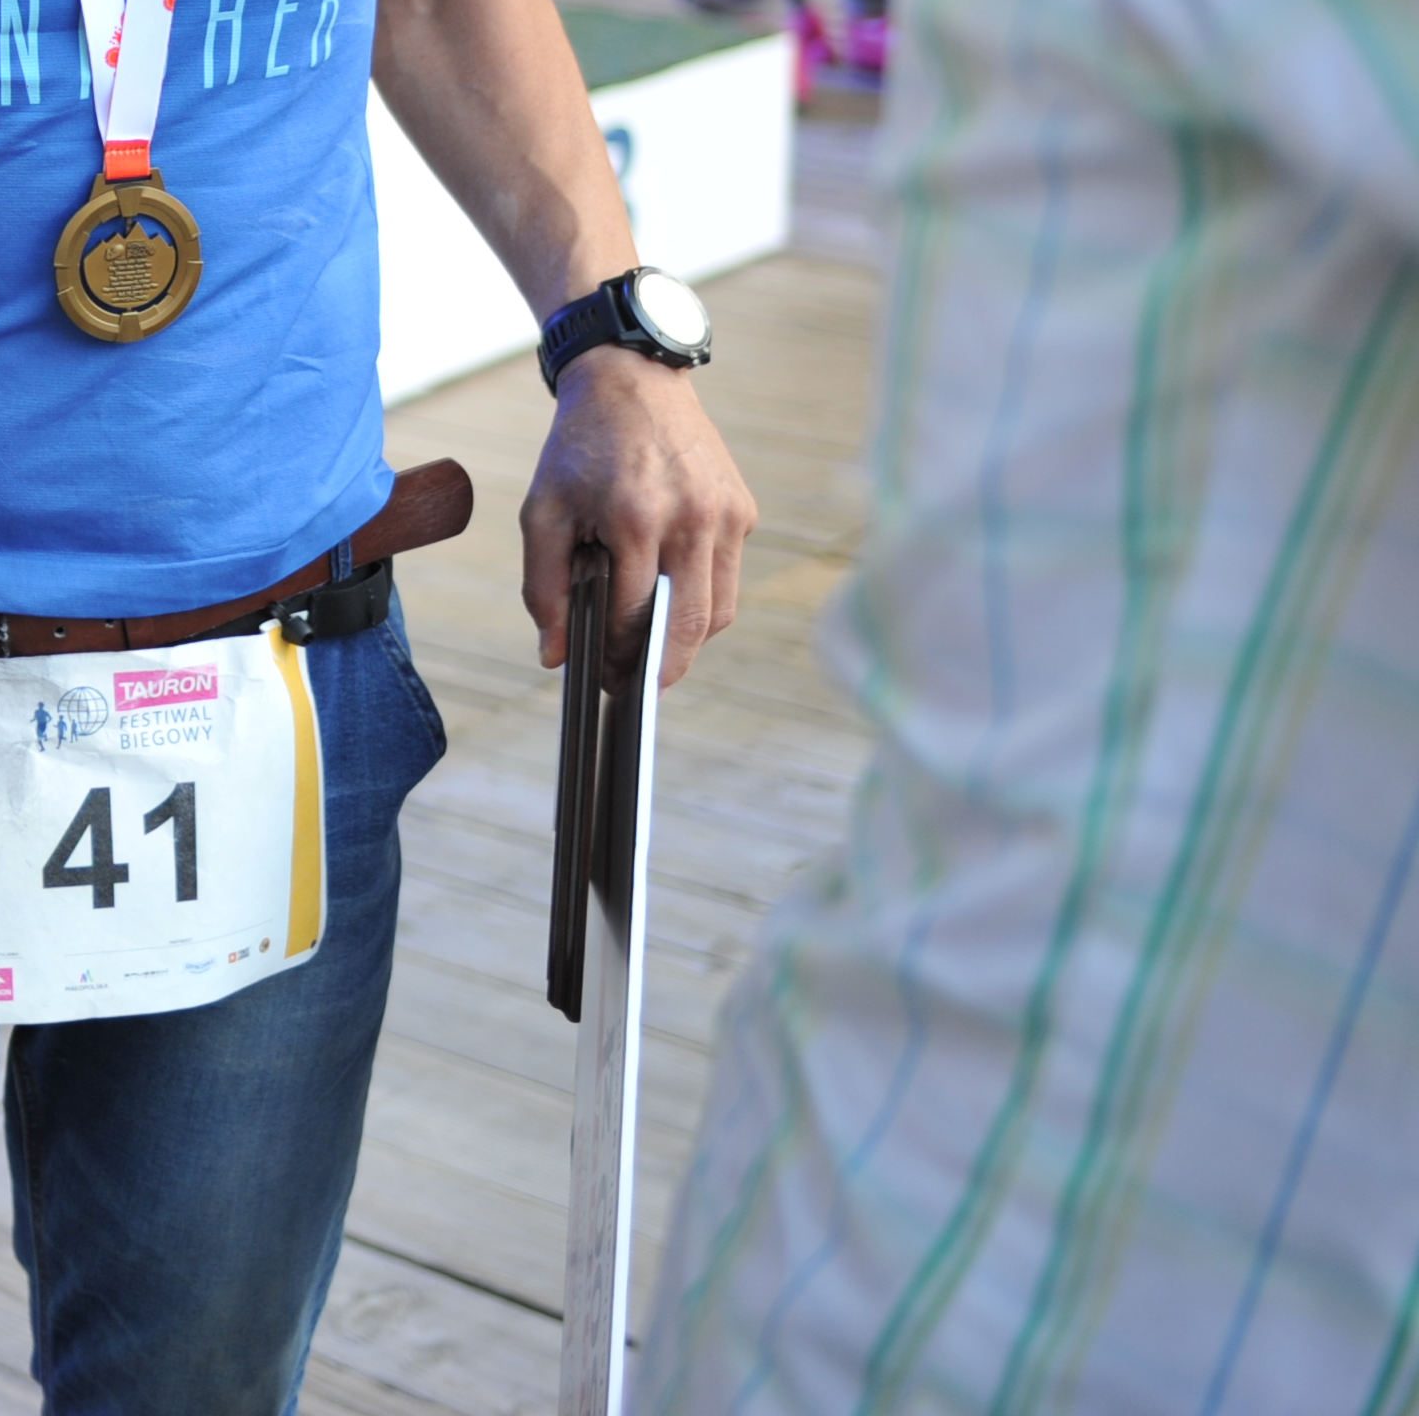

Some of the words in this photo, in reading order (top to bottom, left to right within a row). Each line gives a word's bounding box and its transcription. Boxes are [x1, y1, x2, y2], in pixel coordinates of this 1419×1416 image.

[118, 673, 213, 702] TAURON
[119, 705, 213, 730] FESTIWAL
[120, 724, 213, 750] BIEGOWY
[42, 781, 199, 909] 41
